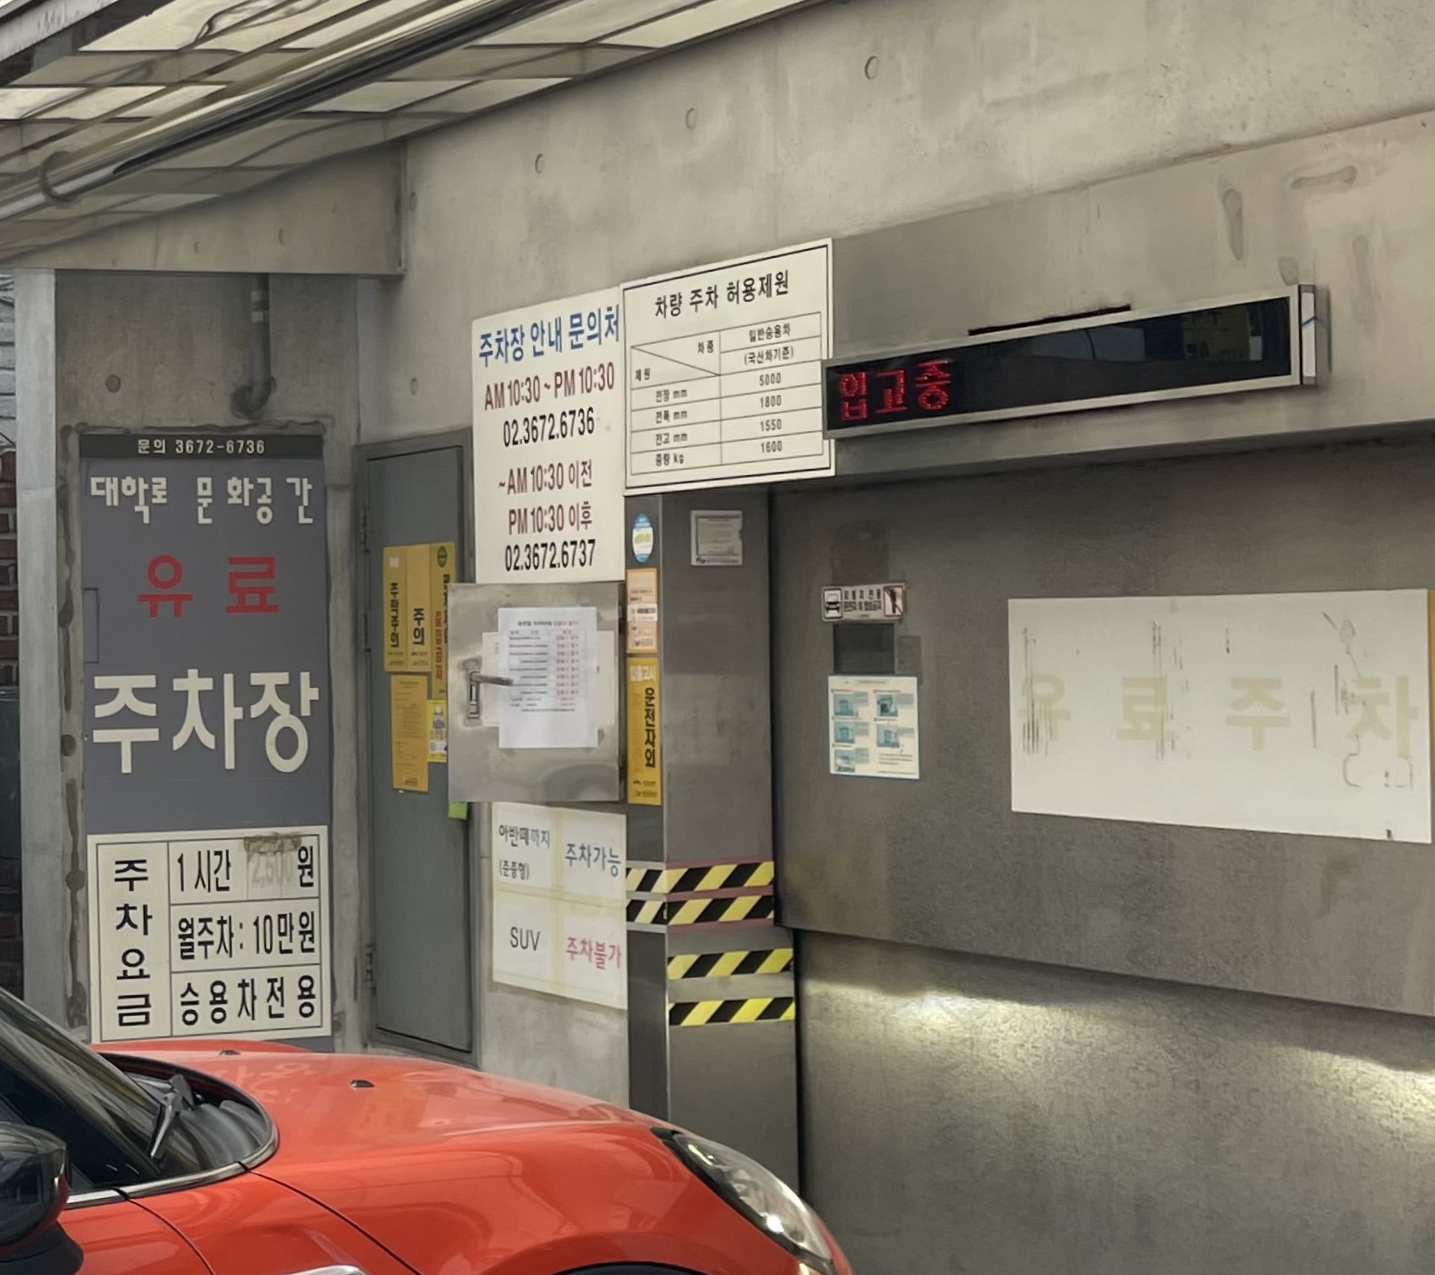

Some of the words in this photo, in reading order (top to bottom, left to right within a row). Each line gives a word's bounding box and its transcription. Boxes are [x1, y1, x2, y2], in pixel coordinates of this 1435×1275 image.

[654, 291, 682, 319] 차량
[689, 285, 718, 313] 주차
[726, 270, 789, 306] 허용제원
[479, 324, 525, 367] 주차장
[530, 316, 563, 357] 안내
[569, 304, 620, 350] 문의처
[485, 382, 505, 411] AM
[507, 376, 541, 406] 10:30
[554, 369, 575, 399] PM
[579, 362, 614, 395] 10:30
[759, 373, 781, 386] 5000
[837, 358, 952, 422] 입고중
[760, 395, 782, 408] 1800
[138, 439, 166, 454] 문의
[175, 439, 265, 454] 3672-6736
[503, 406, 595, 447] 02.3672.6736
[531, 463, 564, 493] 10:30
[569, 459, 592, 490] 이전
[90, 476, 167, 524] 대학로
[509, 507, 528, 535] PM
[531, 503, 564, 534] 10:30
[569, 501, 593, 531] 이후
[505, 539, 596, 572] 02.3672.6737
[137, 554, 280, 618] 유료
[413, 608, 425, 646] 주의
[92, 668, 320, 774] 주차장
[297, 845, 314, 888] 원
[565, 843, 621, 877] 주차가능
[113, 859, 154, 1027] 주차요금
[253, 911, 315, 954] 10만원
[510, 926, 541, 952] SUV
[565, 937, 621, 970] 주차불가
